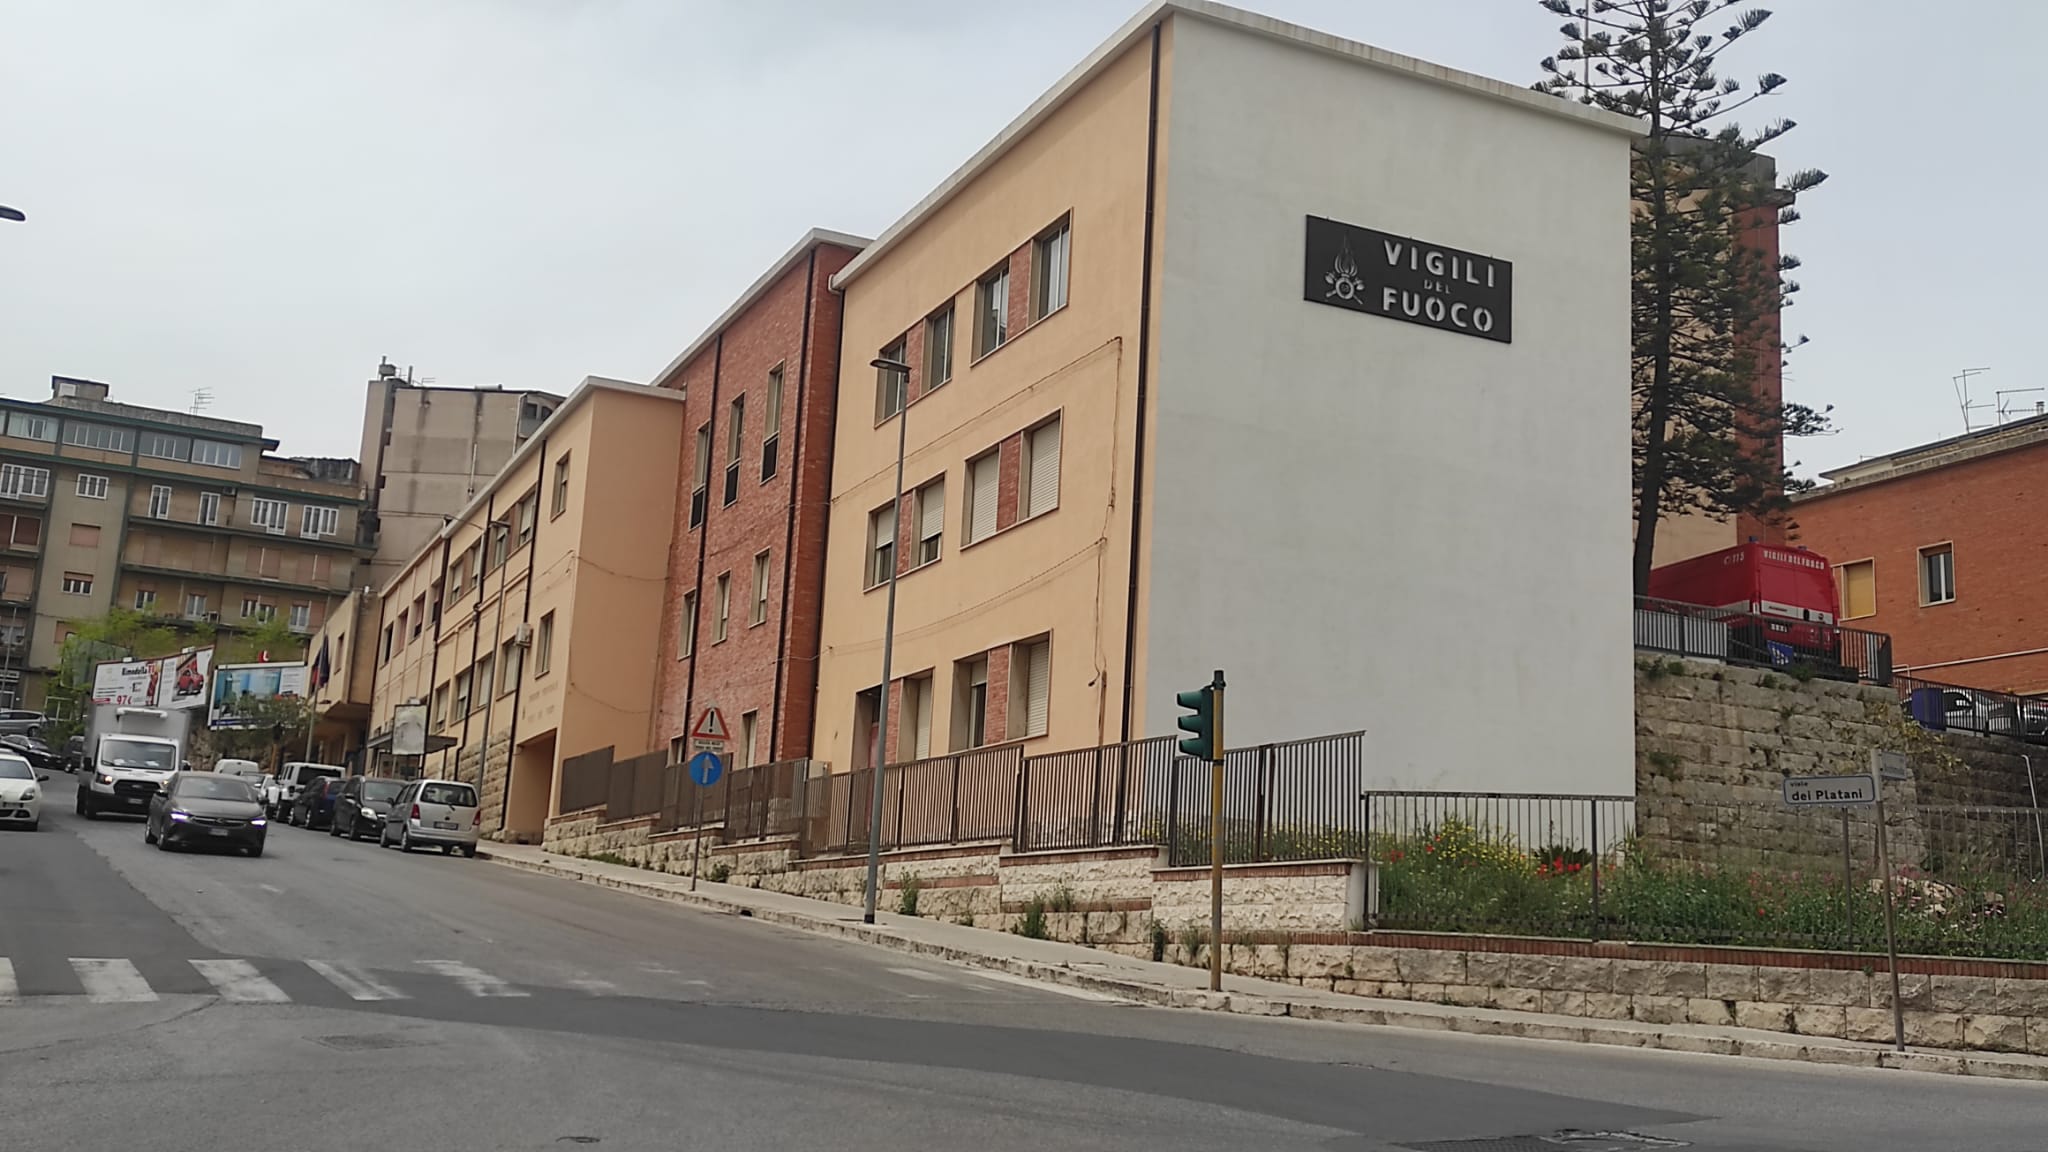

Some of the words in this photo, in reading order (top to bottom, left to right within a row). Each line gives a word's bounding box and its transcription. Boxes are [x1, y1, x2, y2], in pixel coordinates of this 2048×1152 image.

[1384, 239, 1495, 288] VIGILI
[1424, 279, 1450, 294] DEL
[1383, 286, 1493, 332] FUOCO
[1792, 790, 1811, 801] dei
[1816, 788, 1863, 800] Platani
